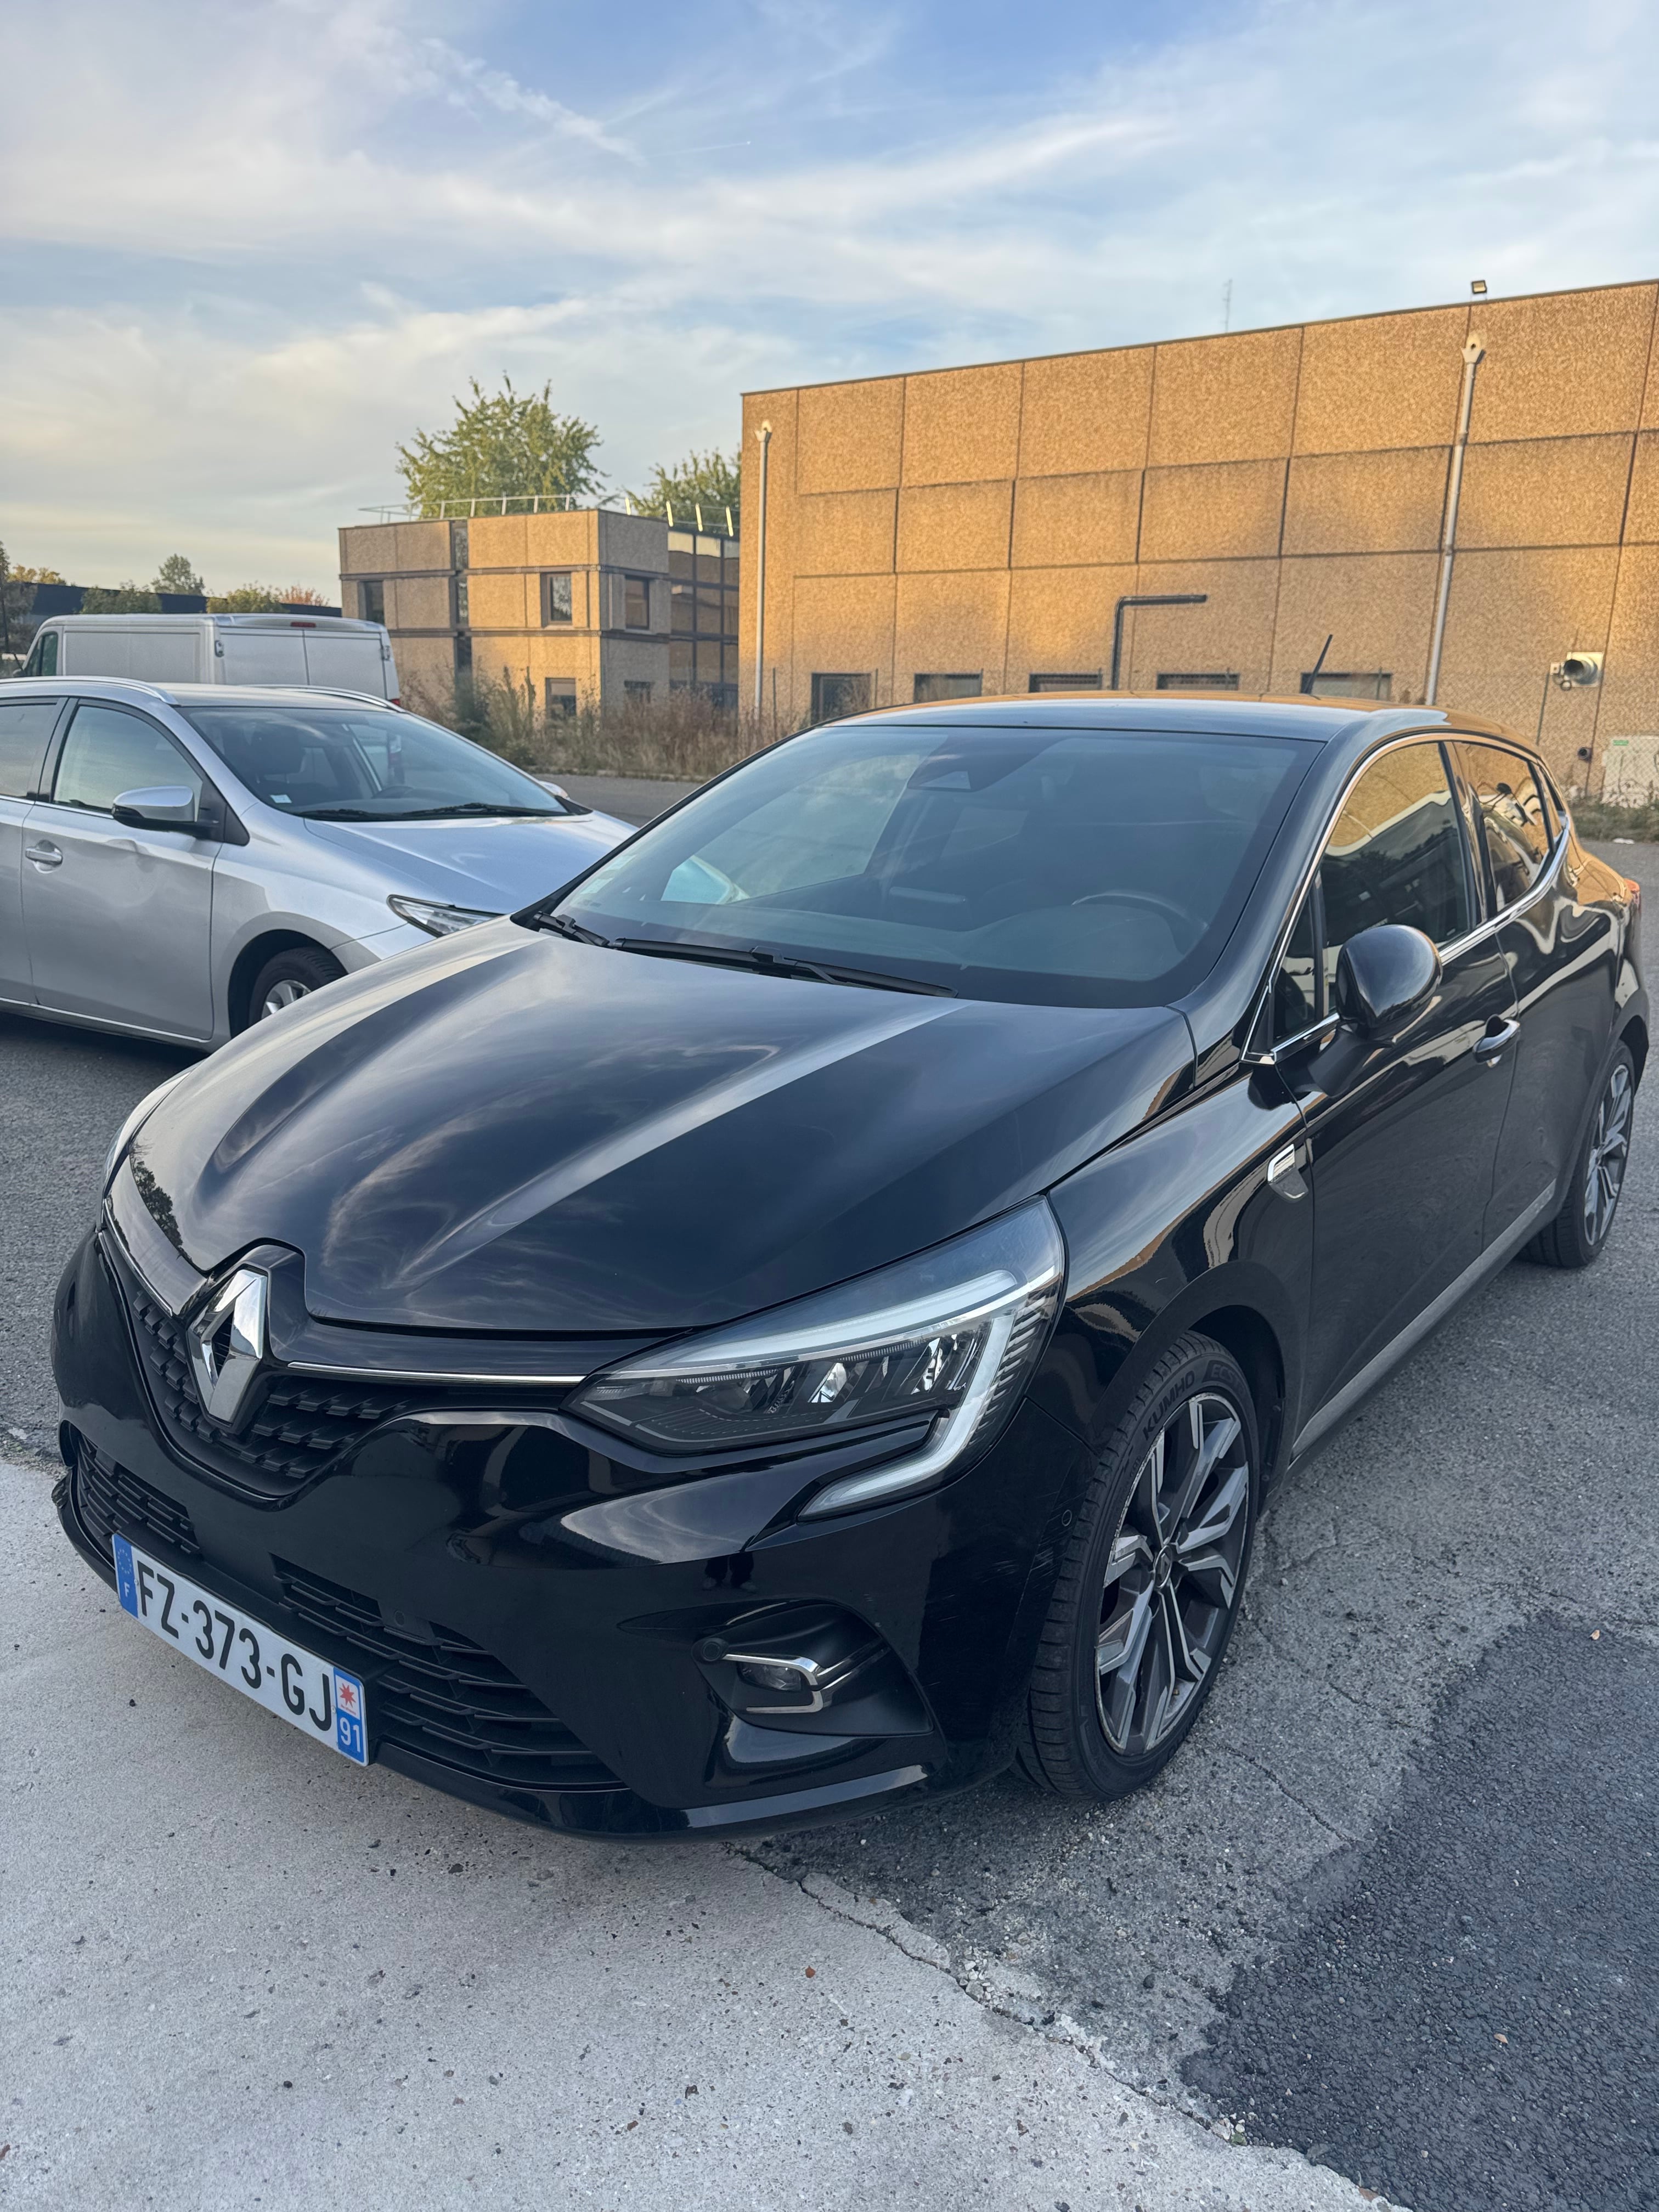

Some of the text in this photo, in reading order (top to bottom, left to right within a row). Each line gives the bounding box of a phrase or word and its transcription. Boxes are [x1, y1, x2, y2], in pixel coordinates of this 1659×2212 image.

[1143, 1370, 1195, 1441] KUMHO
[124, 1582, 130, 1598] F
[137, 1560, 332, 1731] FZ-373-GJ
[340, 1717, 360, 1753] 91
